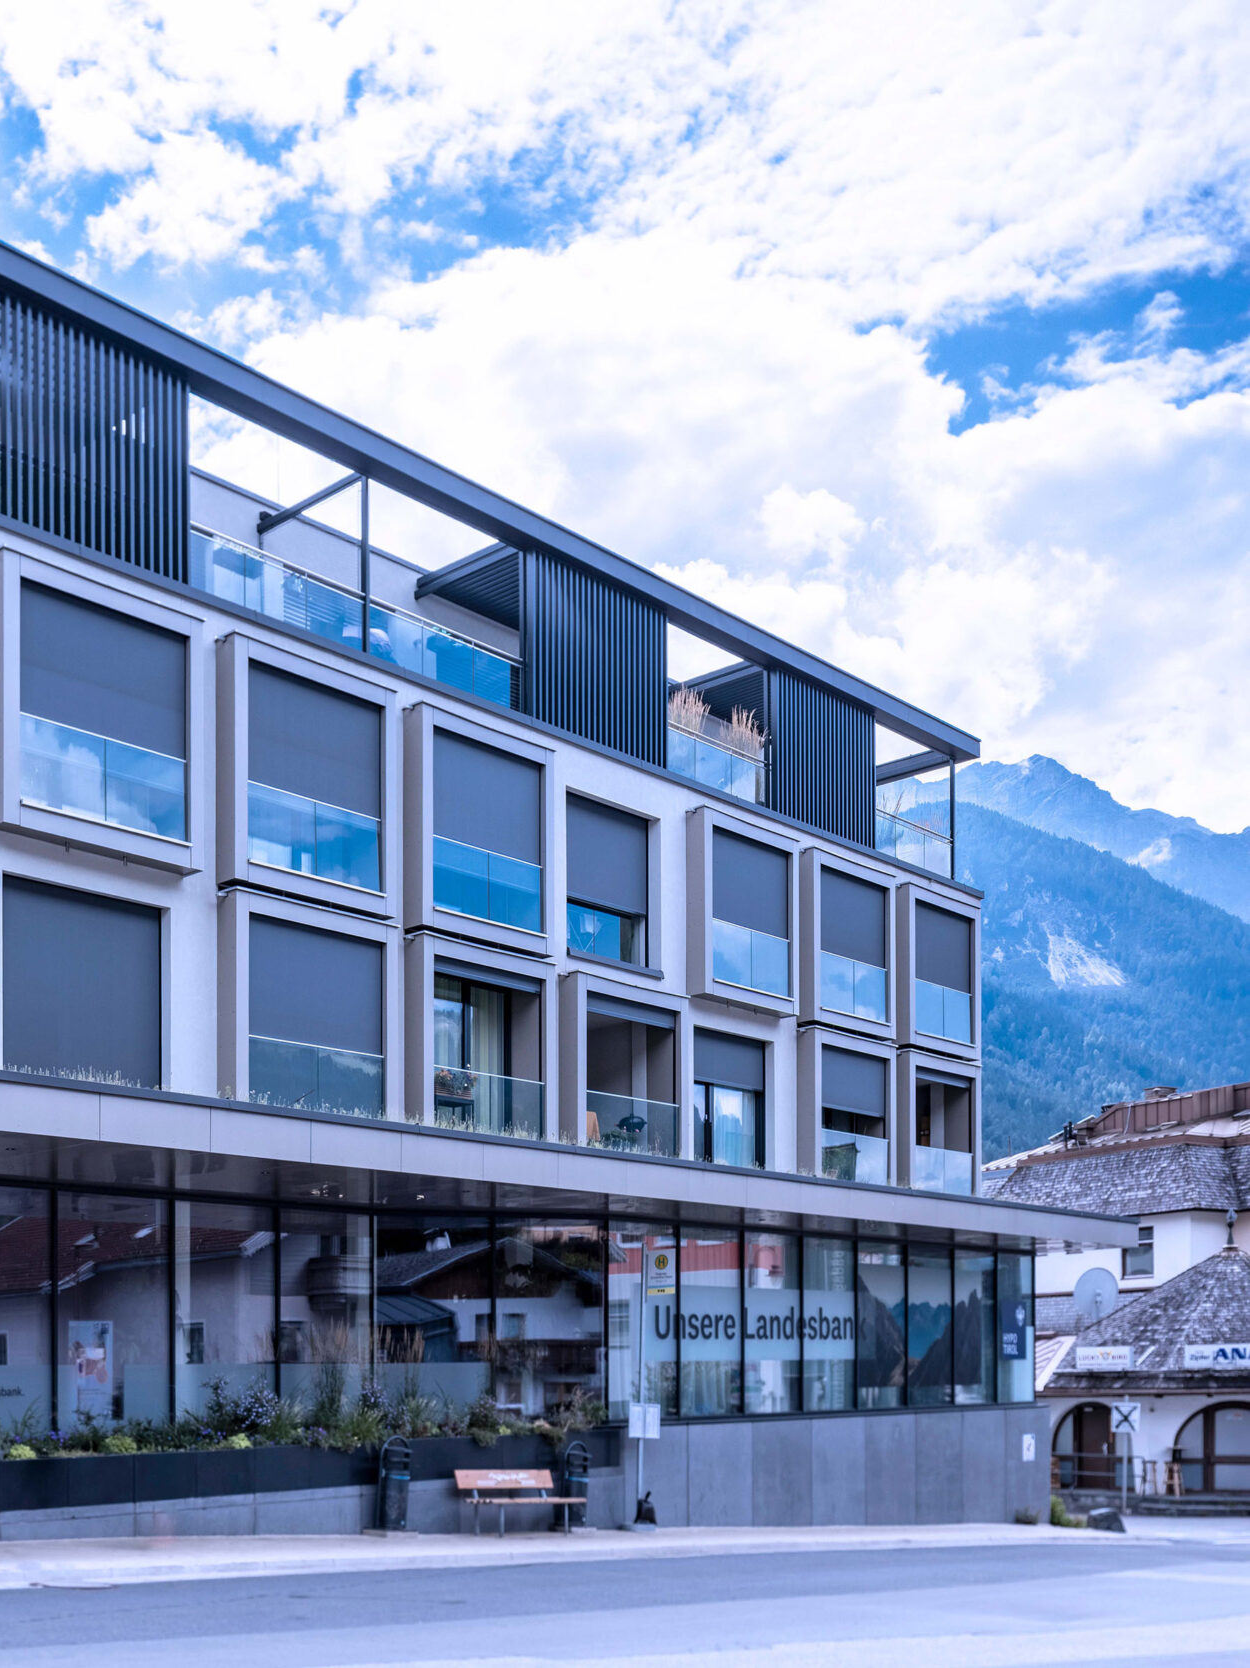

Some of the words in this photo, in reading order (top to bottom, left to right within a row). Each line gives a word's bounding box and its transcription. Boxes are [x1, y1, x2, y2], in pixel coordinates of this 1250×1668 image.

[654, 1305, 736, 1340] Unsere
[1003, 1333, 1018, 1344] HYPO
[1213, 1347, 1250, 1361] AN
